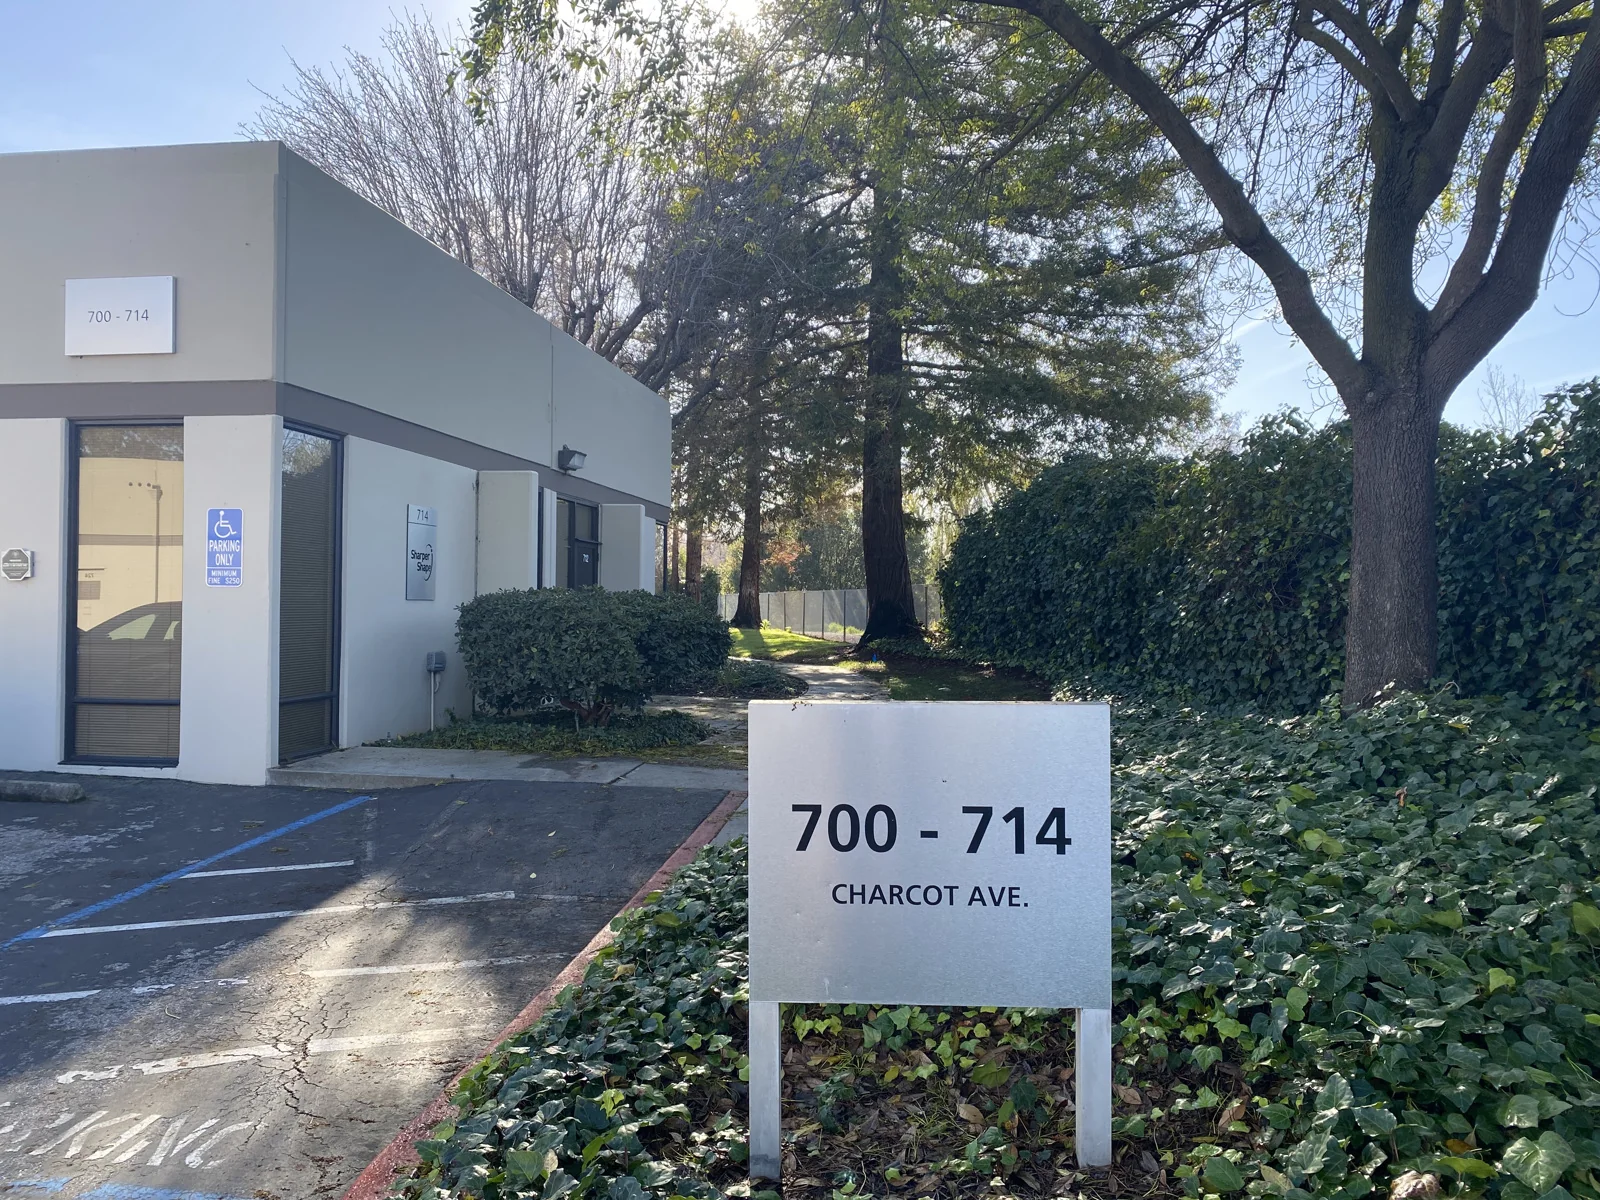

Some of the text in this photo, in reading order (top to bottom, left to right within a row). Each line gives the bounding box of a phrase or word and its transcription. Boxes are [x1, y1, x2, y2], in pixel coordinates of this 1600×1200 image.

[87, 310, 112, 323] 700
[125, 309, 149, 322] 714
[416, 508, 429, 521] 714
[208, 540, 241, 552] PARKING
[215, 553, 234, 566] ONLY
[411, 549, 431, 562] Sharper
[211, 569, 237, 577] MINIMUM
[791, 804, 1072, 855] 700 - 714
[831, 884, 1029, 907] CHARCOT AVE.
